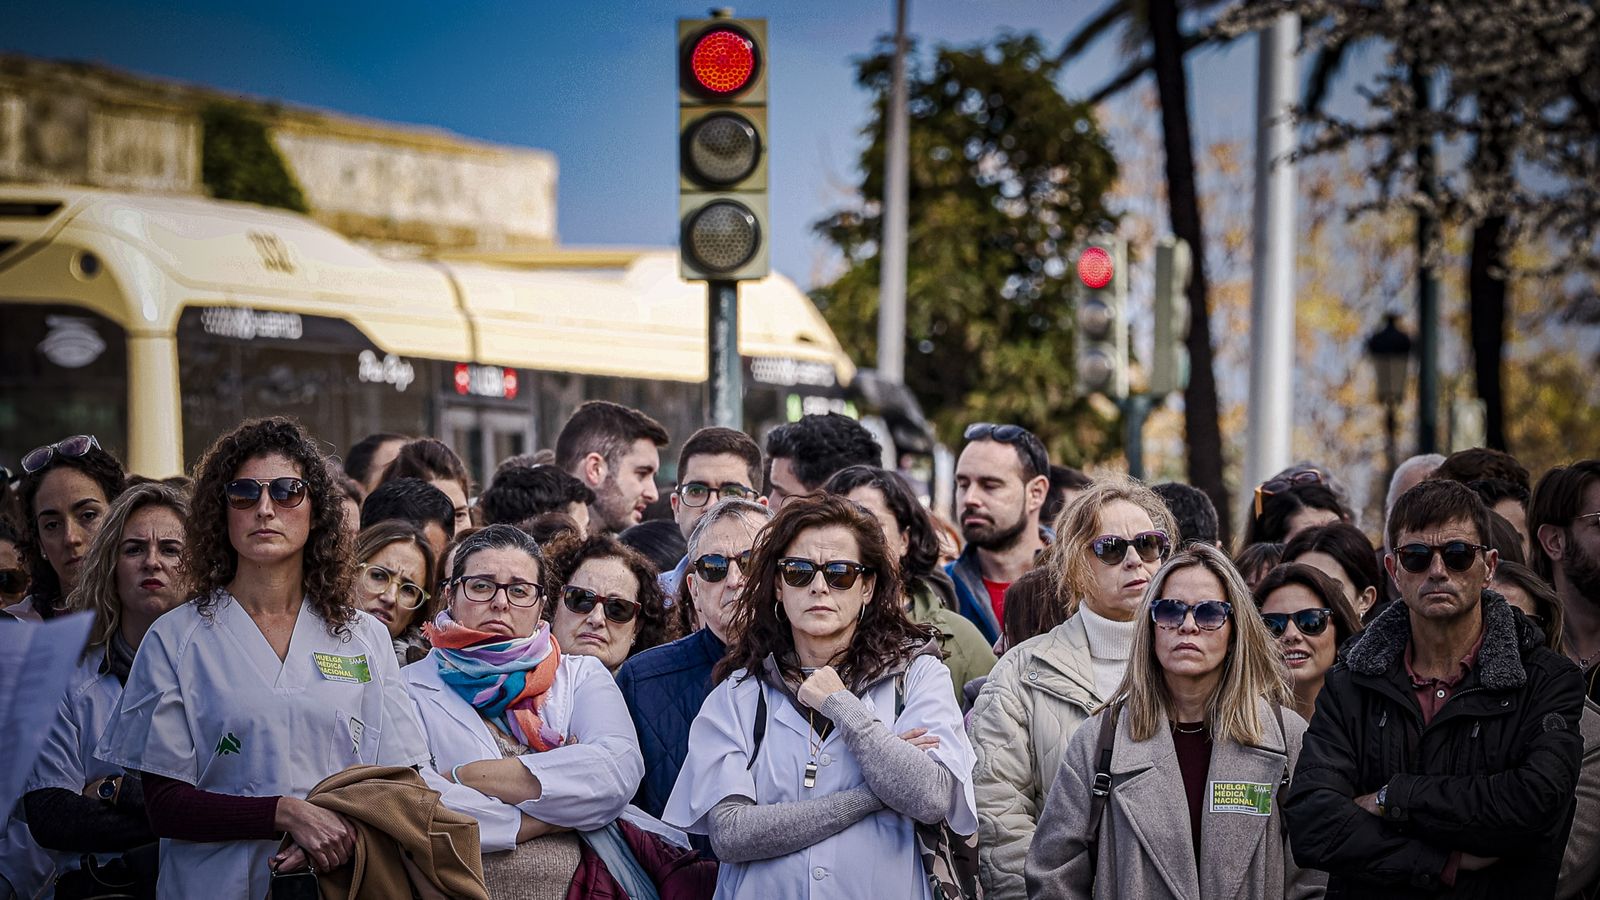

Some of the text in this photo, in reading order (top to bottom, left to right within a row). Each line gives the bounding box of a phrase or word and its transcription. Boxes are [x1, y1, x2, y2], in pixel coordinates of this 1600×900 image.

[316, 654, 342, 663] HUELGA
[317, 660, 342, 670] MÉDICA
[1214, 790, 1244, 798] MÉDICA
[1214, 798, 1254, 806] NACIONAL
